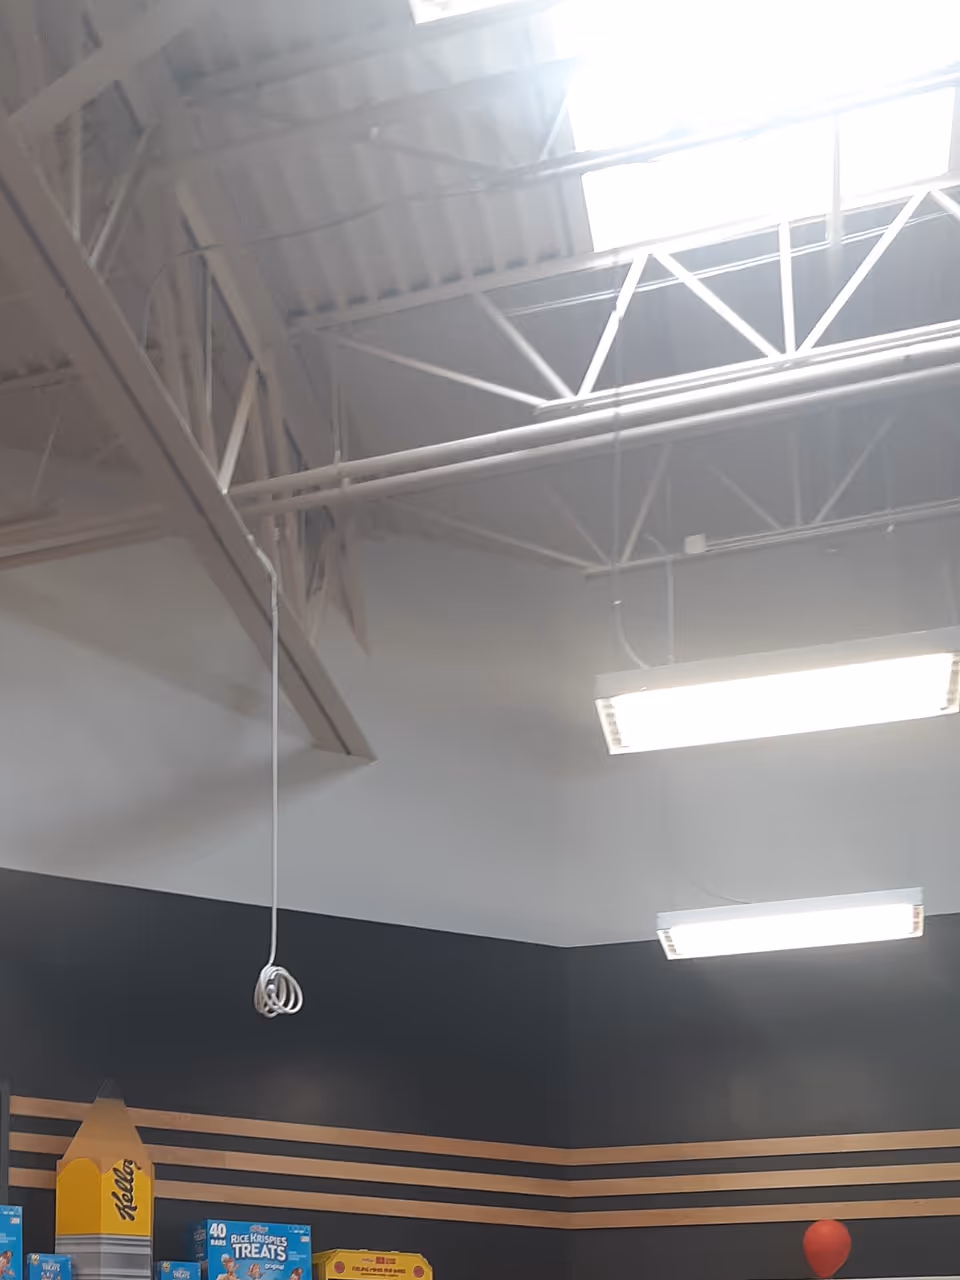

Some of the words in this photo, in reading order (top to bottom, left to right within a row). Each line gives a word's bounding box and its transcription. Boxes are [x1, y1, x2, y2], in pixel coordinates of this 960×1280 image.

[209, 1223, 227, 1238] 40
[230, 1234, 249, 1244] RICE
[250, 1233, 288, 1247] KRISPIES
[232, 1243, 286, 1261] TREATS
